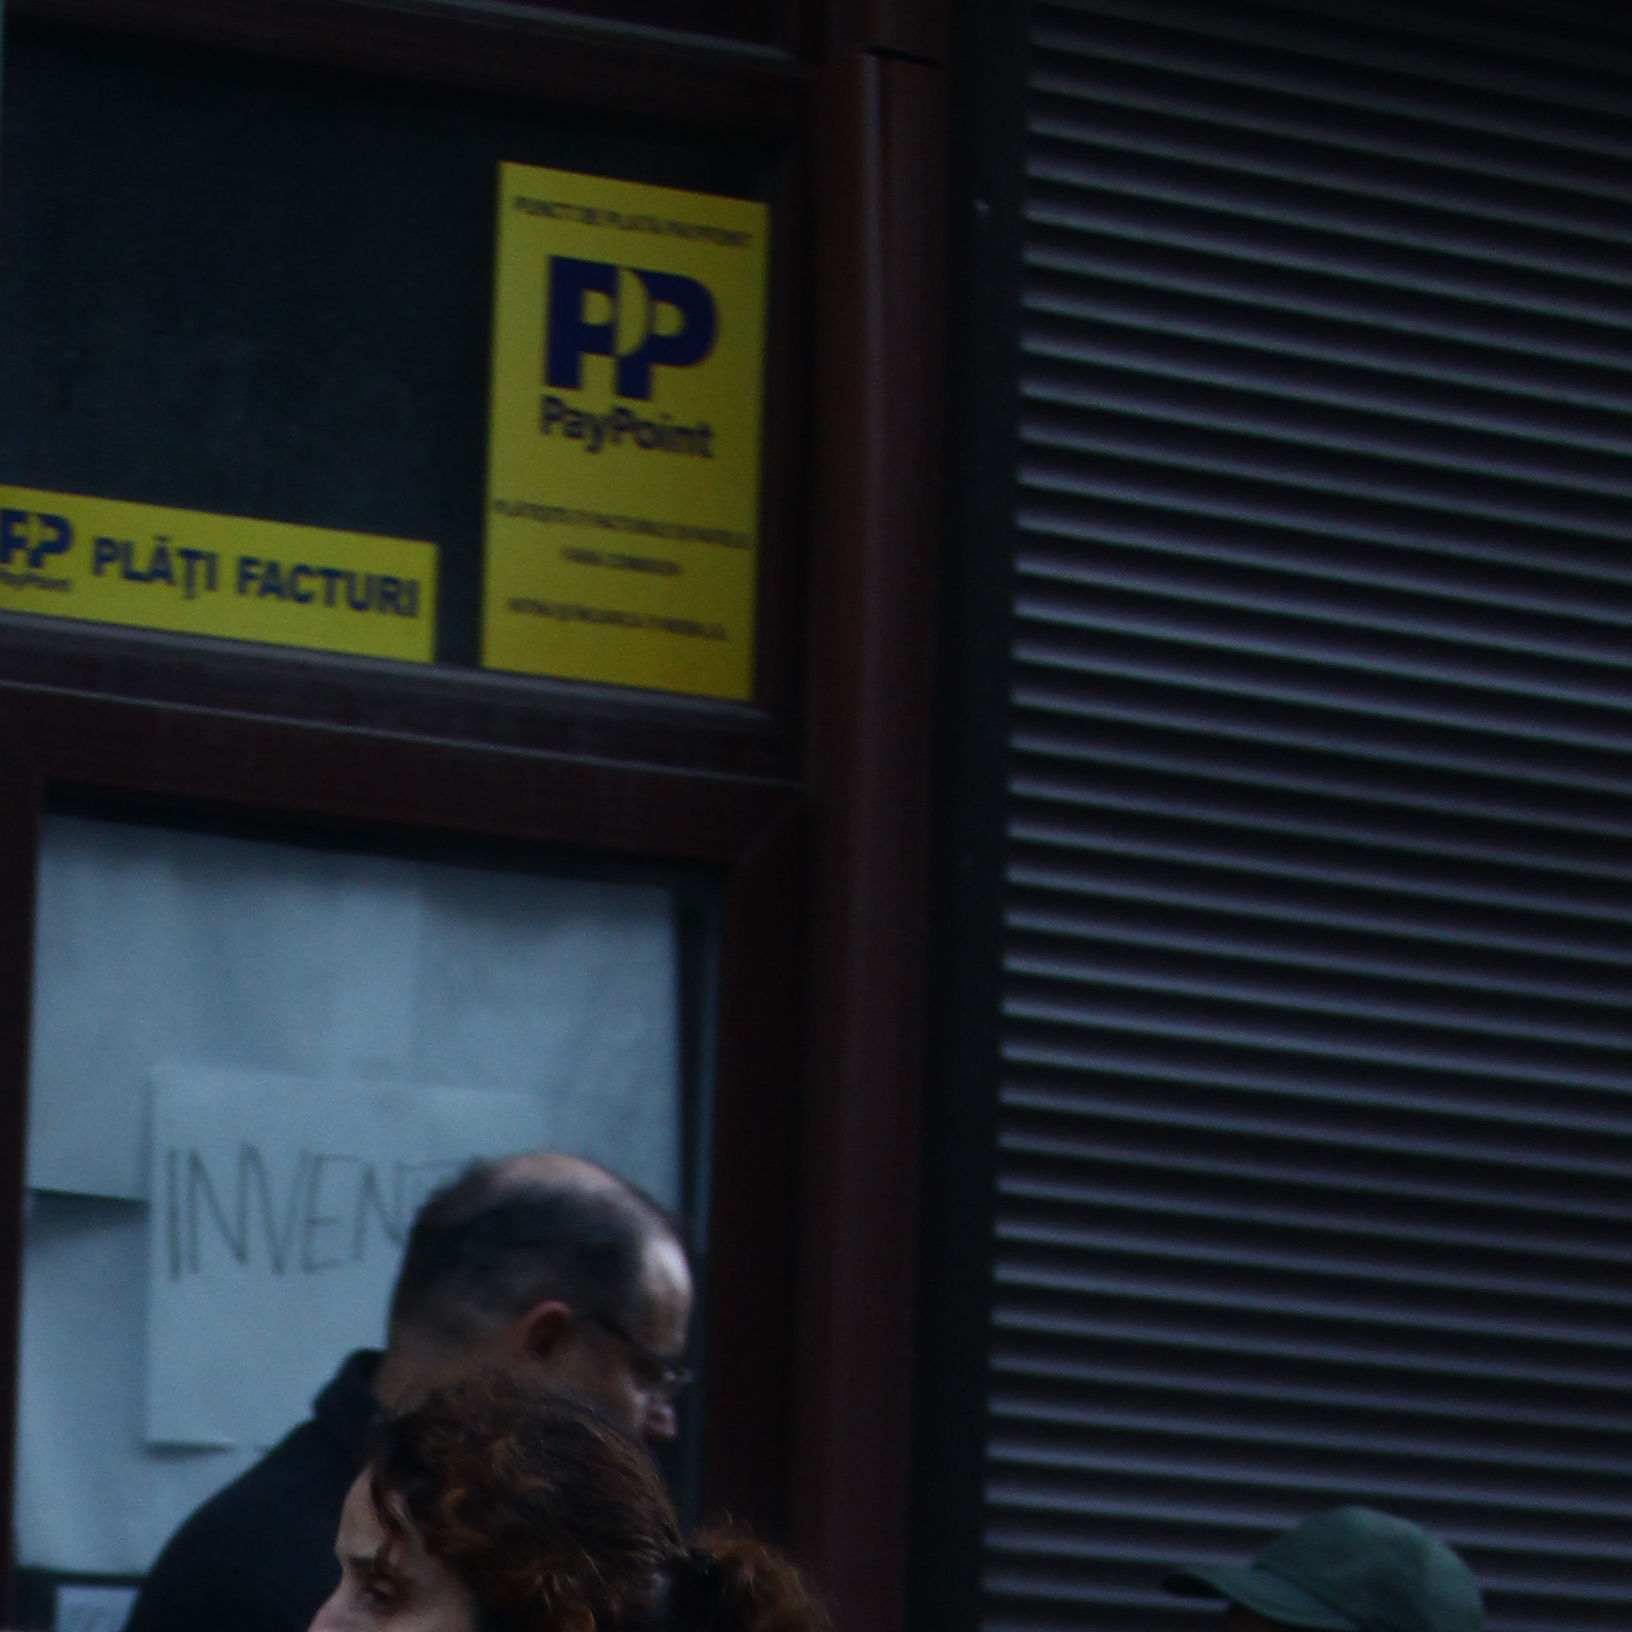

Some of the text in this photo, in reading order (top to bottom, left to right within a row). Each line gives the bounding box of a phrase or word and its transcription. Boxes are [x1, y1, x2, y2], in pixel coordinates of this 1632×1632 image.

[539, 394, 714, 460] PayPoint
[235, 554, 421, 617] FACTURI
[165, 1141, 458, 1283] INVEN
